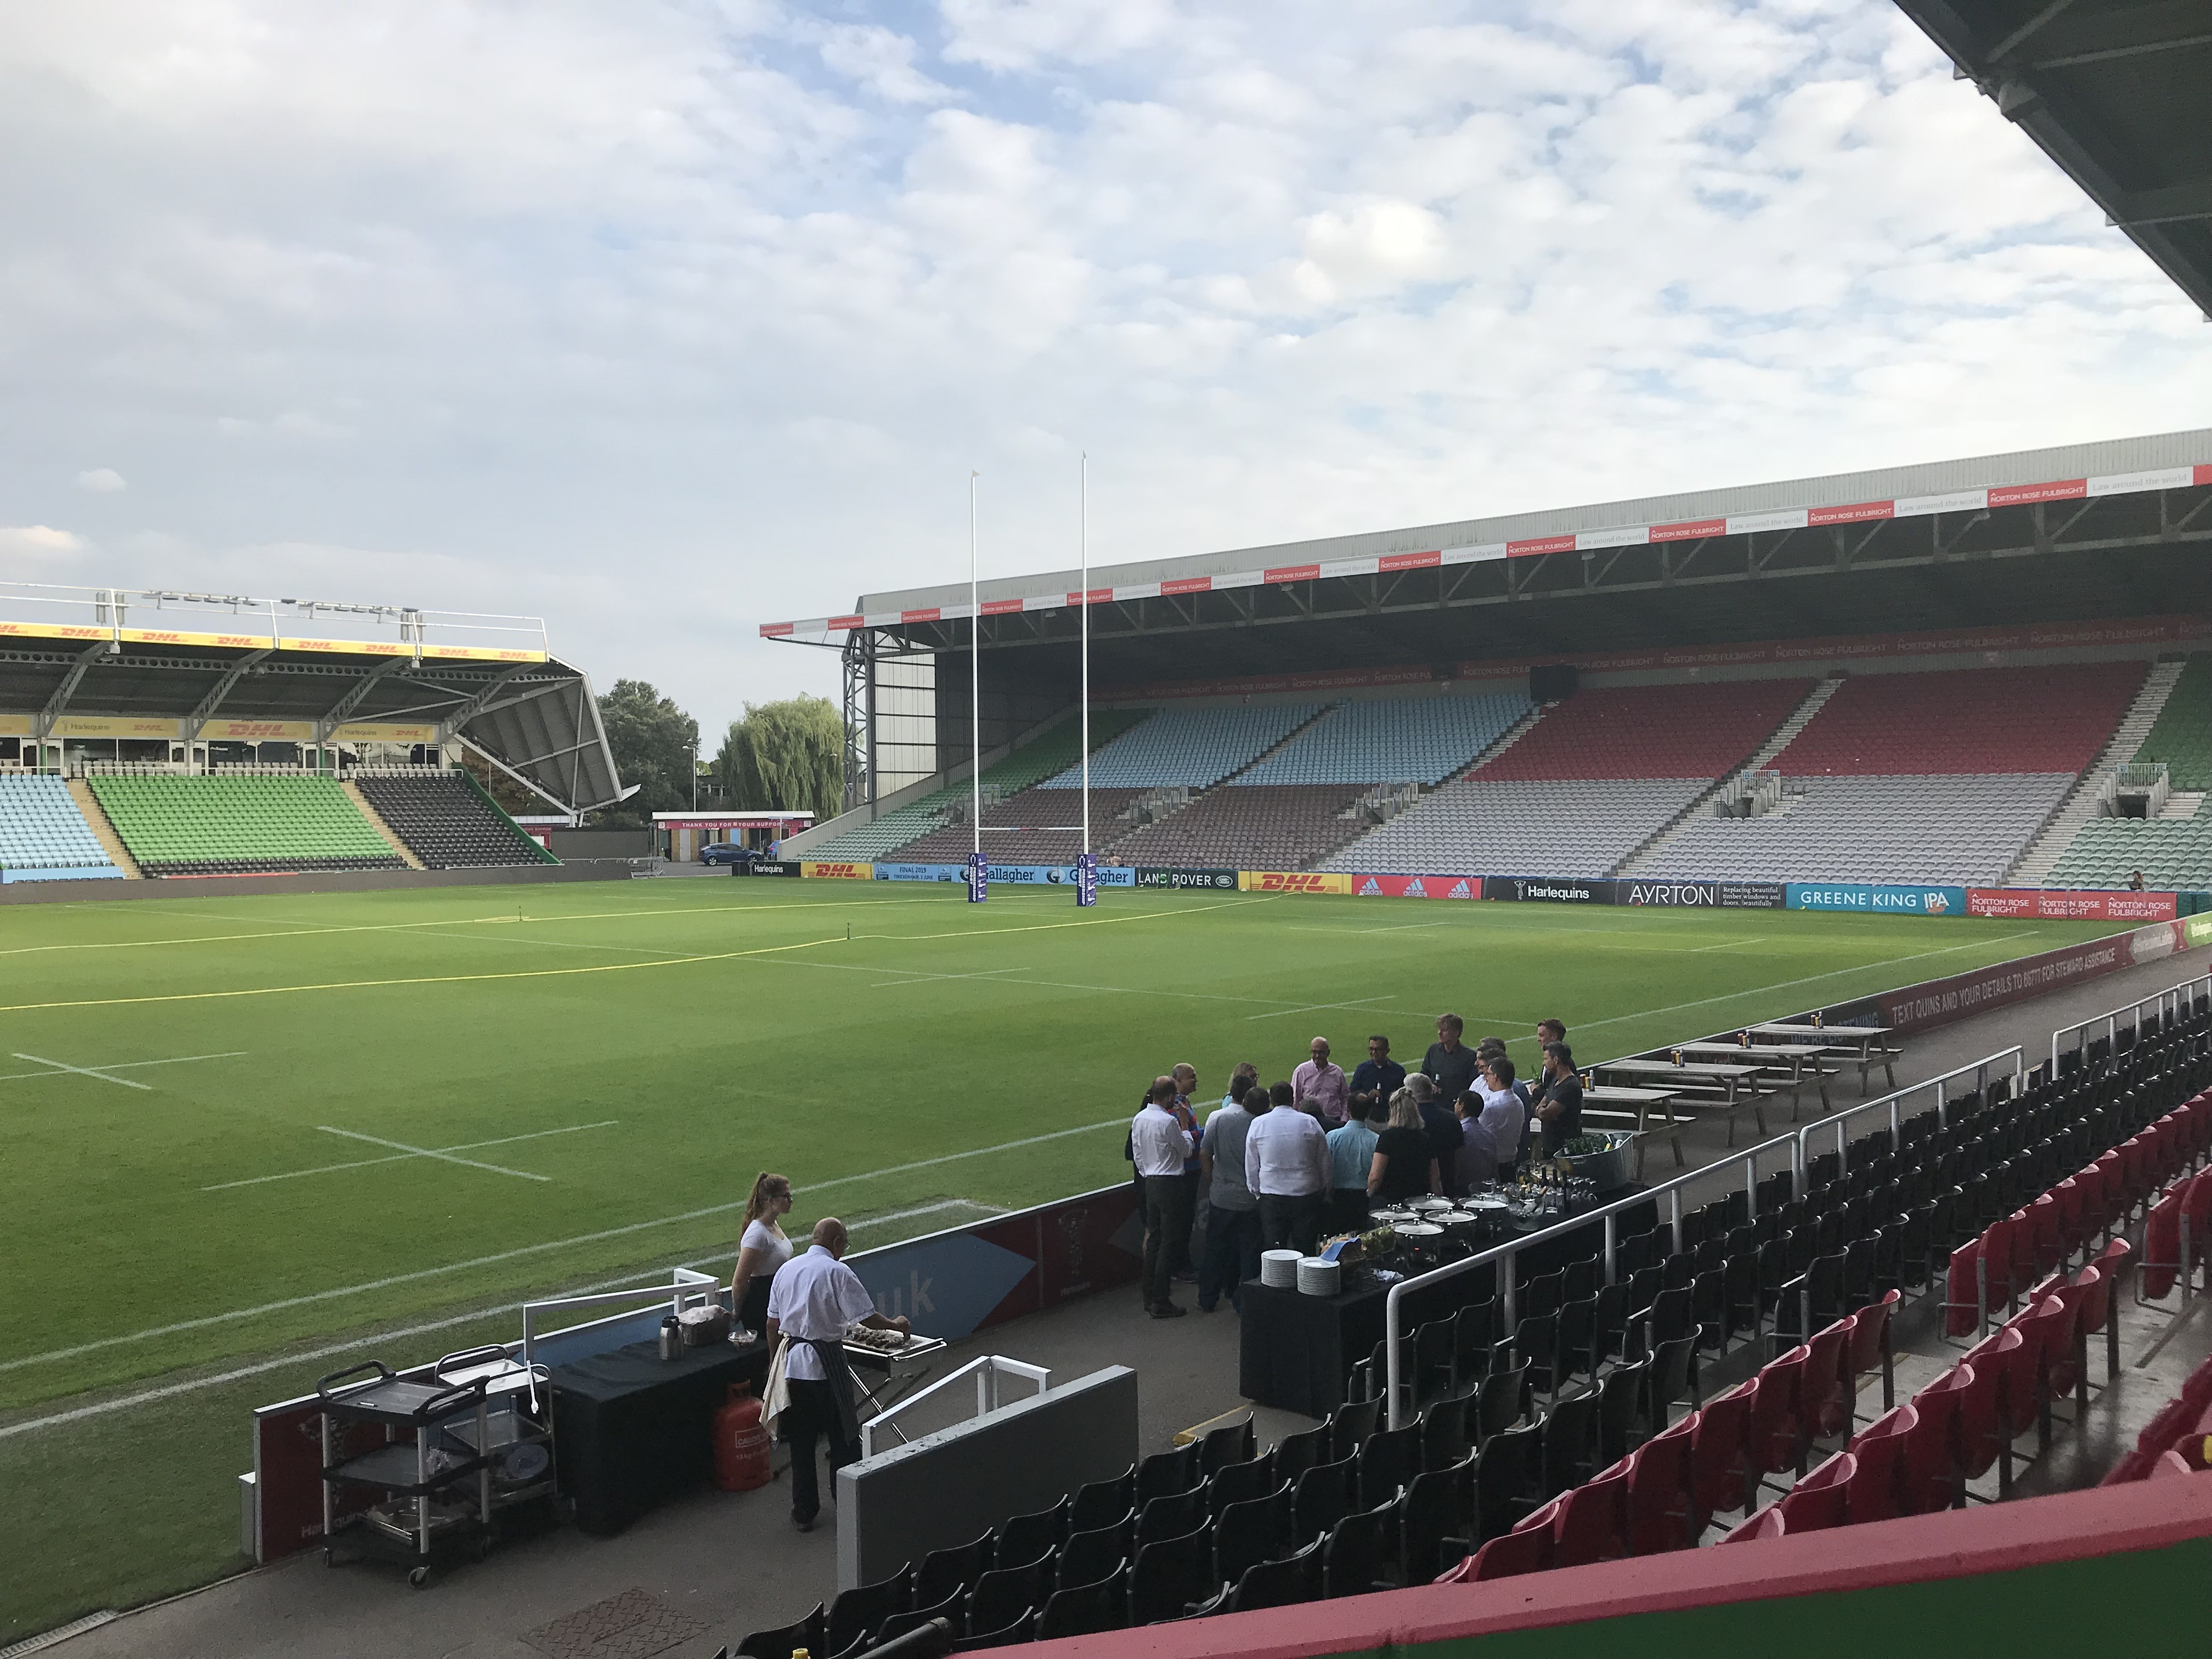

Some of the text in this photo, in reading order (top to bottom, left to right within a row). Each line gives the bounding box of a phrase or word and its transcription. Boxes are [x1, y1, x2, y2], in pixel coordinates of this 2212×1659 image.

[2112, 478, 2143, 489] around
[2146, 477, 2159, 486] the
[2162, 474, 2187, 484] world
[1991, 494, 2020, 503] NORTON
[2042, 487, 2084, 497] FULBRIGHT
[1916, 501, 1943, 510] around
[1960, 496, 1982, 506] world
[1810, 514, 1837, 522] NORTON
[1855, 508, 1892, 517] FULBRIGHT
[1746, 520, 1769, 528] around
[1783, 516, 1803, 524] world
[1692, 526, 1724, 535] FULBRIGHT
[1593, 536, 1614, 544] around
[1456, 551, 1476, 560] around
[60, 628, 101, 637] DHL
[143, 633, 180, 642] DHL
[217, 637, 253, 645] DHL
[298, 641, 332, 650] DHL
[228, 724, 285, 735] DHL
[755, 865, 783, 873] Harlequins
[816, 864, 857, 877] DHL
[986, 868, 1034, 883] allagher
[1138, 873, 1211, 886] LAND ROVER
[1261, 874, 1326, 891] DHL
[1528, 885, 1589, 900] Harlequins
[1629, 885, 1713, 905] AYRTON
[1801, 891, 1950, 909] GREENE KING IPA
[2108, 909, 2159, 917] FULBRIGHT
[1893, 1002, 1914, 1025] TEXT
[1916, 995, 1940, 1018] QUINS
[1942, 991, 1957, 1012] AND
[1959, 983, 1980, 1006] YOUR
[1982, 975, 2012, 1000] DETAILS
[2013, 973, 2022, 990] TO
[2042, 964, 2055, 982] FOR
[2056, 957, 2083, 978] STEWARD
[2085, 948, 2115, 970] ASSISTANCE
